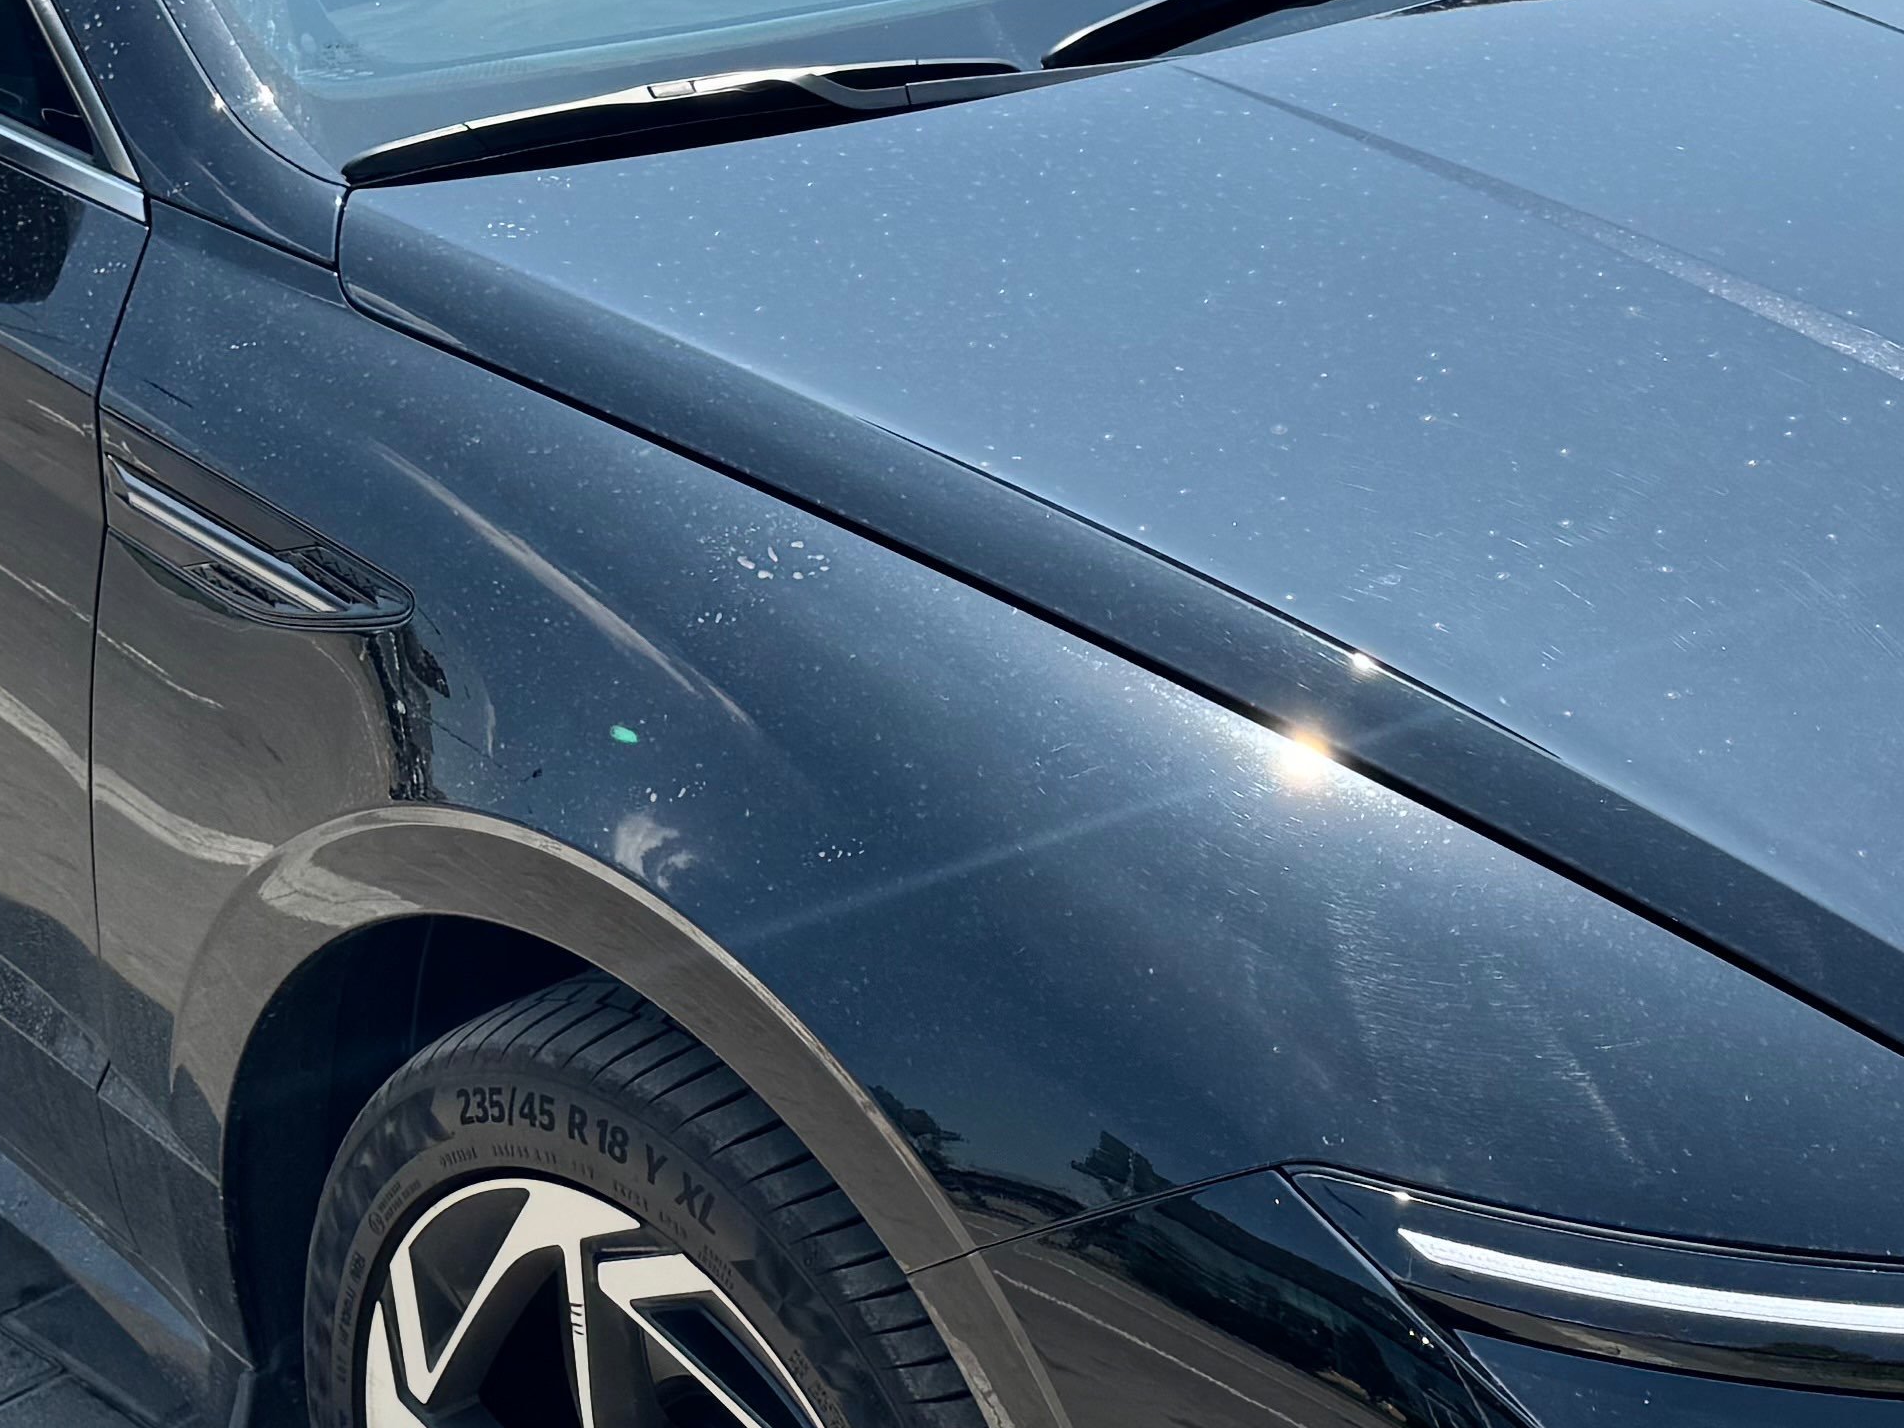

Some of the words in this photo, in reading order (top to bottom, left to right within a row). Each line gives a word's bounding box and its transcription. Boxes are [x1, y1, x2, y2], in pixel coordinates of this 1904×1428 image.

[456, 1086, 555, 1133] 235/45
[646, 1145, 668, 1185] Y
[675, 1172, 716, 1236] XL
